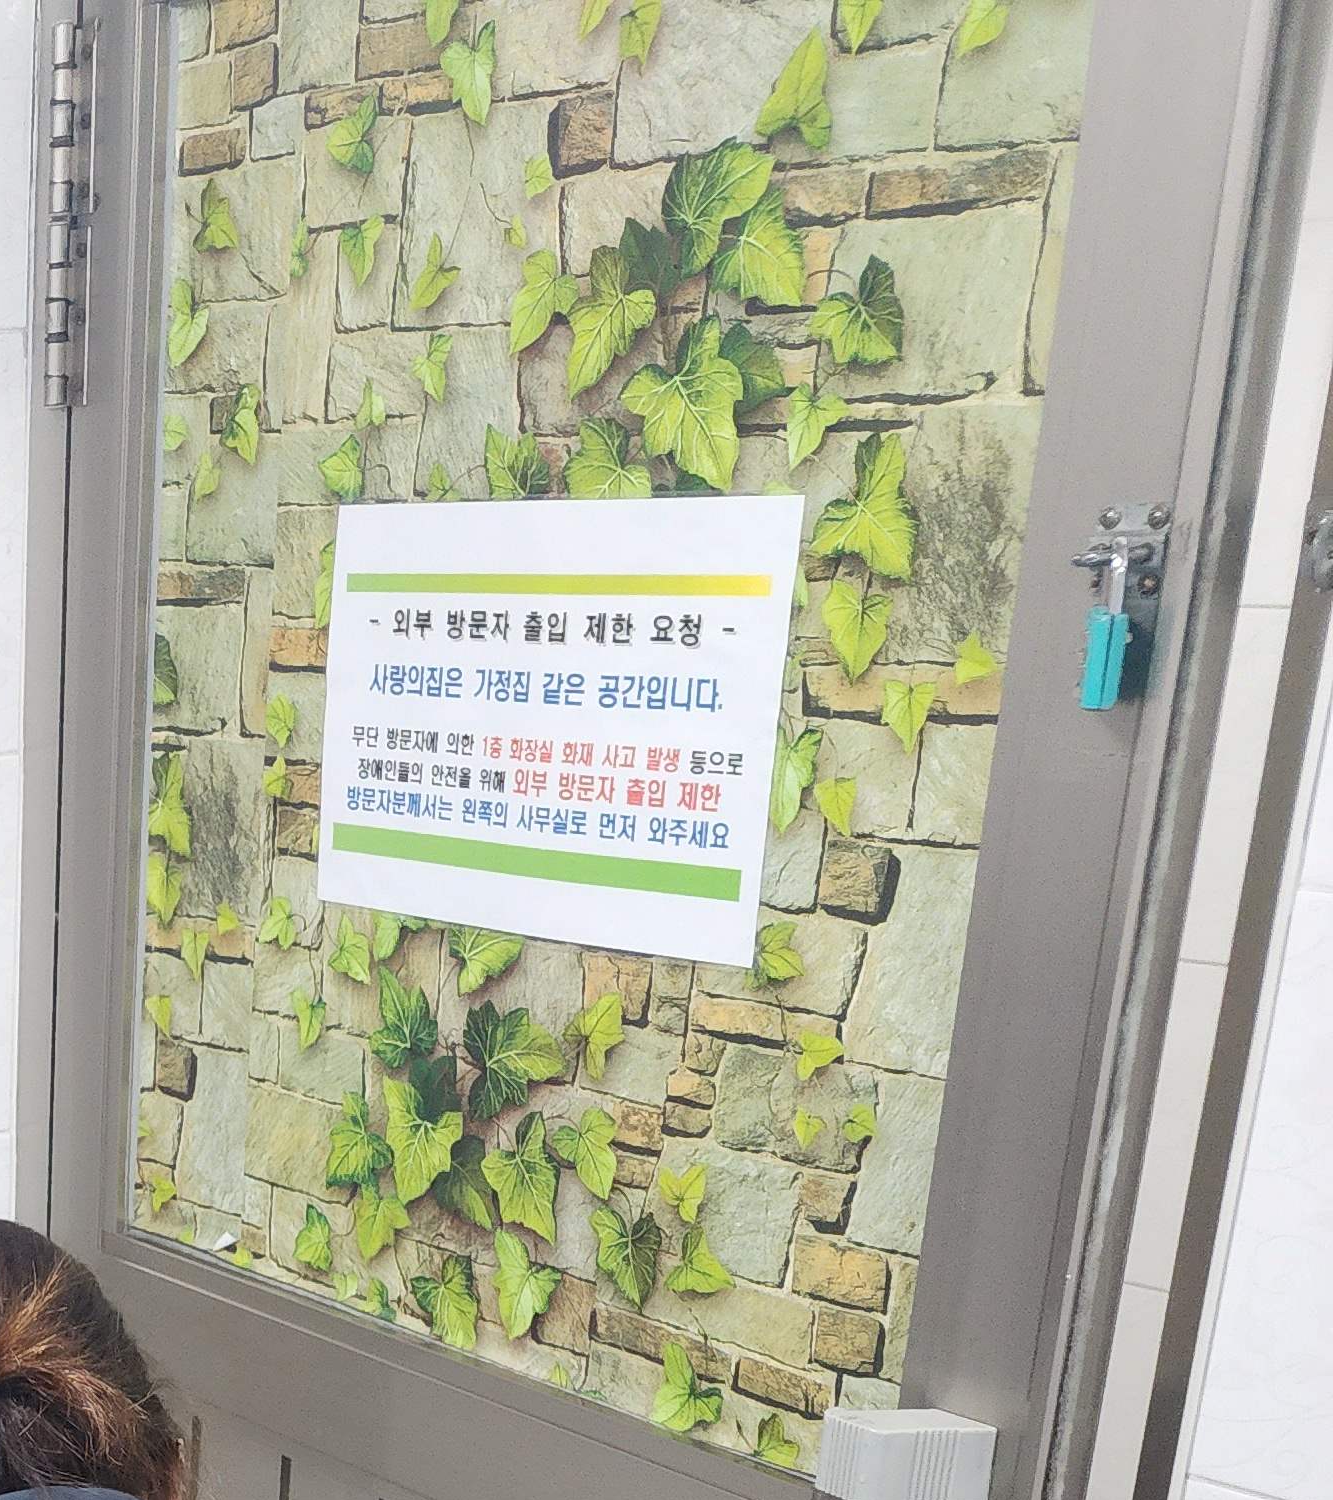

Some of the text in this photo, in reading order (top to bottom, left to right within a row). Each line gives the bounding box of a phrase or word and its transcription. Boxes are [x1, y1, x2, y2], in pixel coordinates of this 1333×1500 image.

[392, 608, 432, 640] 외부
[446, 609, 510, 643] 방문자
[523, 611, 568, 645] 출입
[583, 612, 634, 646] 제한
[650, 613, 703, 649] 요청
[369, 663, 723, 713] 사랑의집은 가정집 같은 공간입니다.
[352, 725, 743, 776] 무단 방문자에 의한 1층 화장실 화재 사고 발생 등으로
[357, 758, 721, 812] 장애인들의 안전을 위해 외부 방문자 출입 제한
[347, 786, 729, 849] 방문자분께서는 왼쪽의 사무실로 먼저 와주세요
